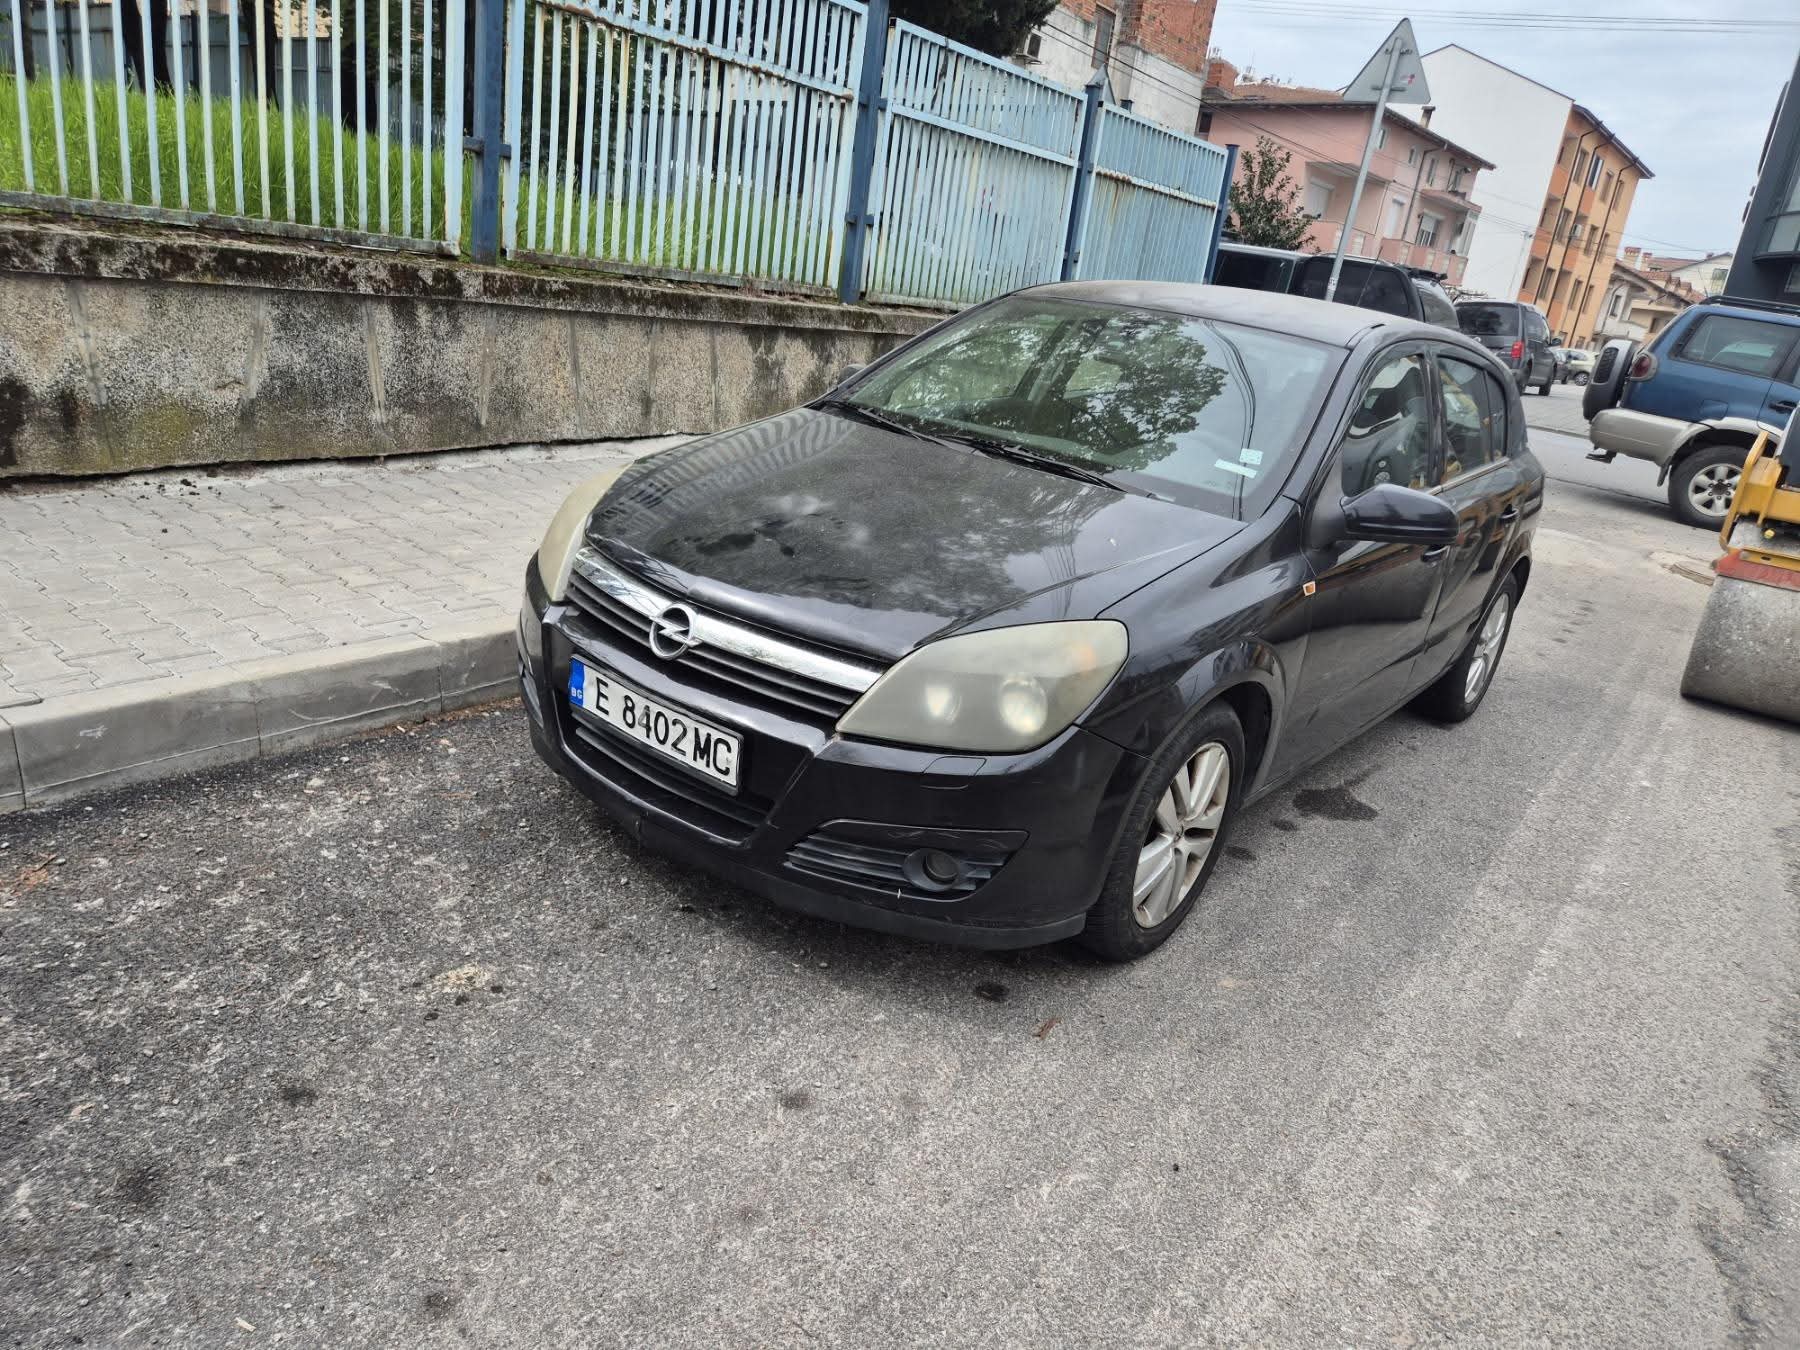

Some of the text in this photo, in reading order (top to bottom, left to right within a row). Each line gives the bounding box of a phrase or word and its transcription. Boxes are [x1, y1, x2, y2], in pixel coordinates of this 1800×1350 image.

[571, 689, 583, 699] BG
[596, 677, 732, 776] E 8402 MC
